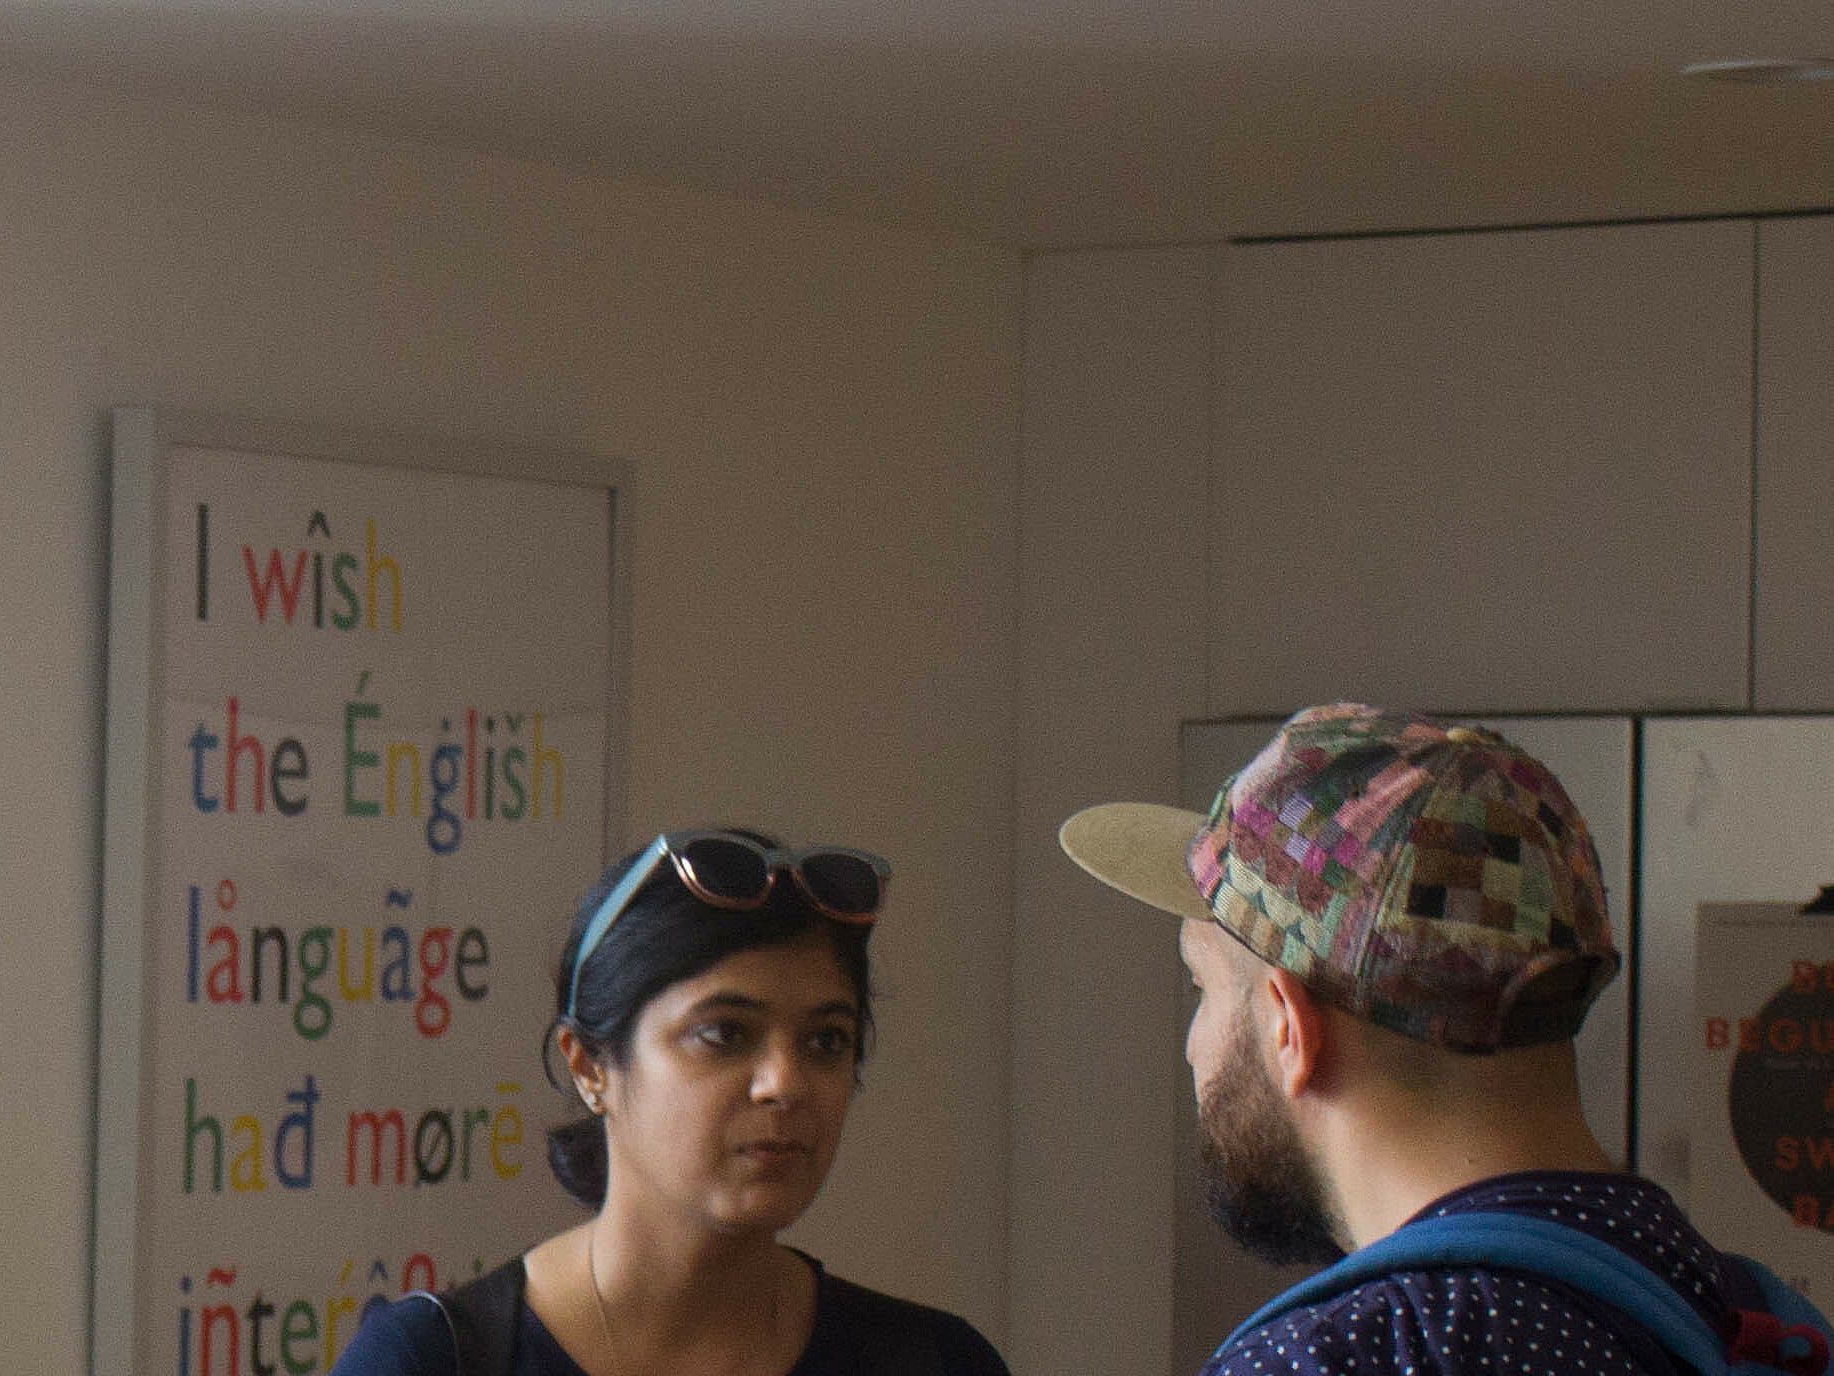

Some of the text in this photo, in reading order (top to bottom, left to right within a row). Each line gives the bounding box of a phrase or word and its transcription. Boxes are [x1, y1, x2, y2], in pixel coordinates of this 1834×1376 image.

[195, 502, 404, 634] I wîsh
[187, 695, 312, 817] the
[185, 878, 491, 1041] långuãge
[345, 1082, 525, 1189] mørē
